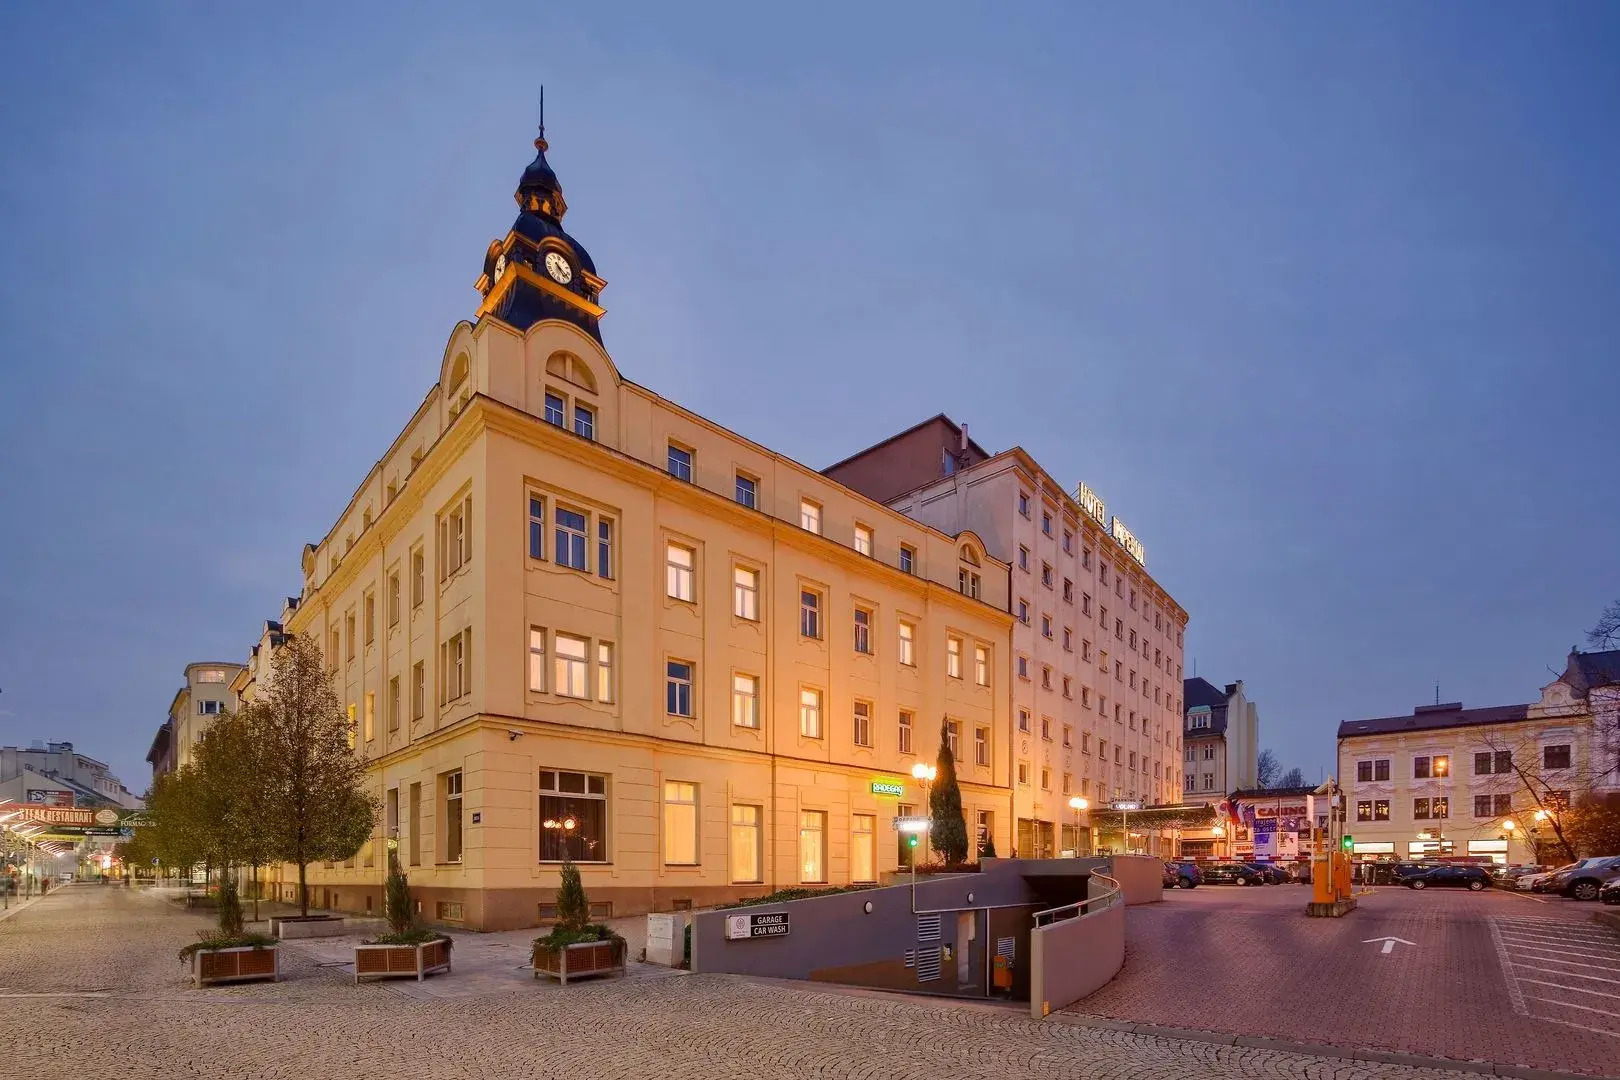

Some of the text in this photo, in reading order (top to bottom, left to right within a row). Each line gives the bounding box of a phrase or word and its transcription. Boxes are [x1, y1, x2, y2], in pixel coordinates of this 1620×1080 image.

[1079, 482, 1106, 527] HOTEL
[18, 808, 46, 821] STEAK
[47, 810, 93, 823] RESTAURANT
[1258, 806, 1307, 816] CASINO
[757, 916, 782, 924] GARAGE
[767, 925, 785, 933] WASH
